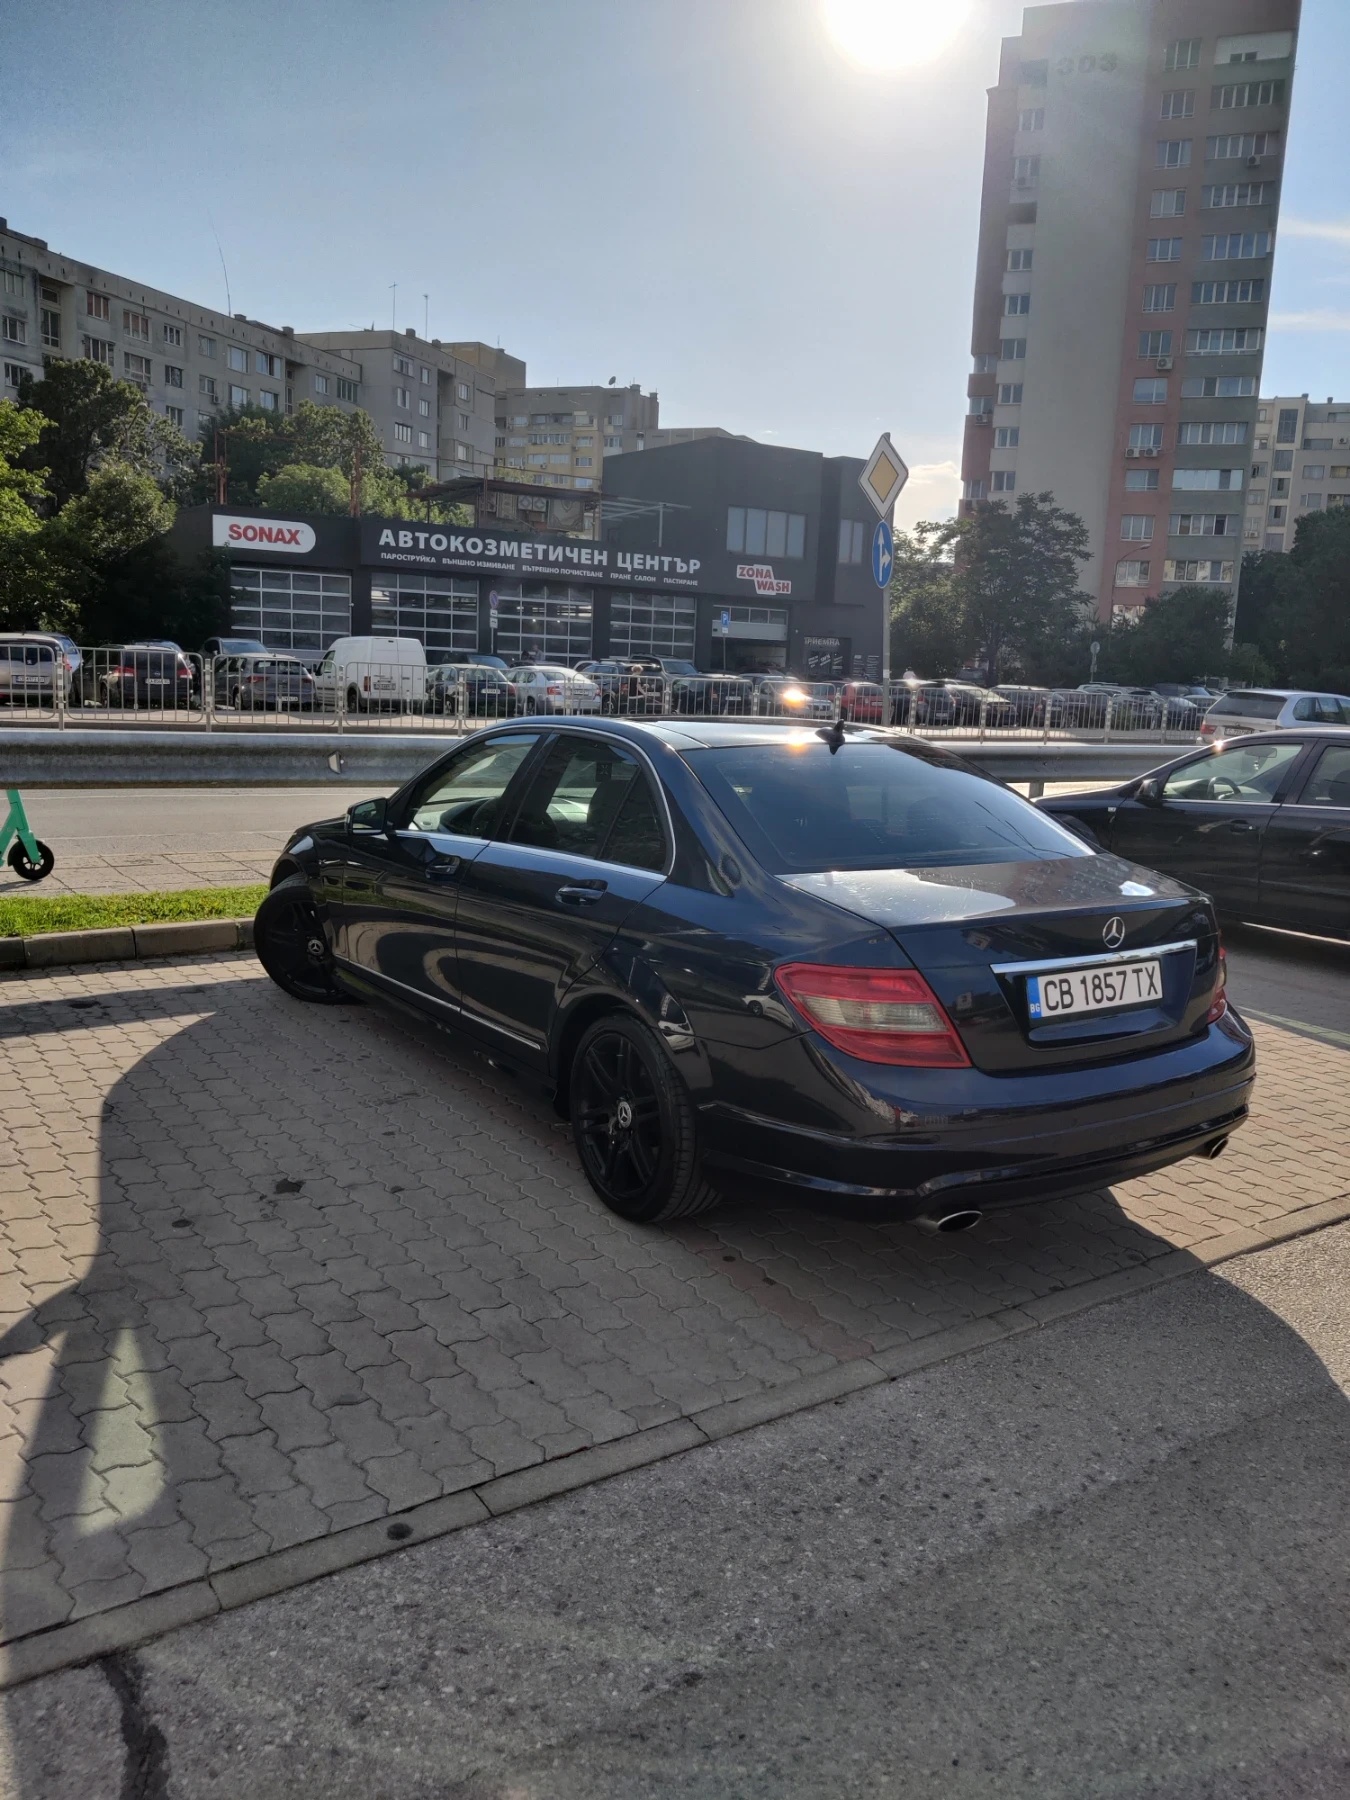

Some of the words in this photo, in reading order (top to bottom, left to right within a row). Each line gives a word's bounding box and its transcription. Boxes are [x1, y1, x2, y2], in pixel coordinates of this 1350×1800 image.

[228, 523, 301, 546] SONAX
[379, 528, 608, 566] АВТОКОЗМЕТИЧЕН
[617, 551, 701, 574] ЦЕНТЪР
[380, 552, 437, 564] ПАРОСТРУЙКА
[442, 557, 476, 567] ВЪНШНО
[476, 561, 516, 571] ИЗМИВАНЕ
[522, 564, 560, 574] ВЪТРЕШНО
[560, 568, 603, 578] ПОЧИСТВАНЕ
[610, 572, 631, 581] ПРАНЕ
[634, 574, 656, 582] САЛОН
[663, 577, 698, 586] ПАСТИРАНЕ
[738, 566, 772, 580] ZONA
[757, 580, 790, 593] WASH
[1044, 978, 1074, 1011] CB
[1080, 970, 1127, 1006] 1857
[1132, 966, 1158, 998] TX
[1030, 1003, 1041, 1013] BG
